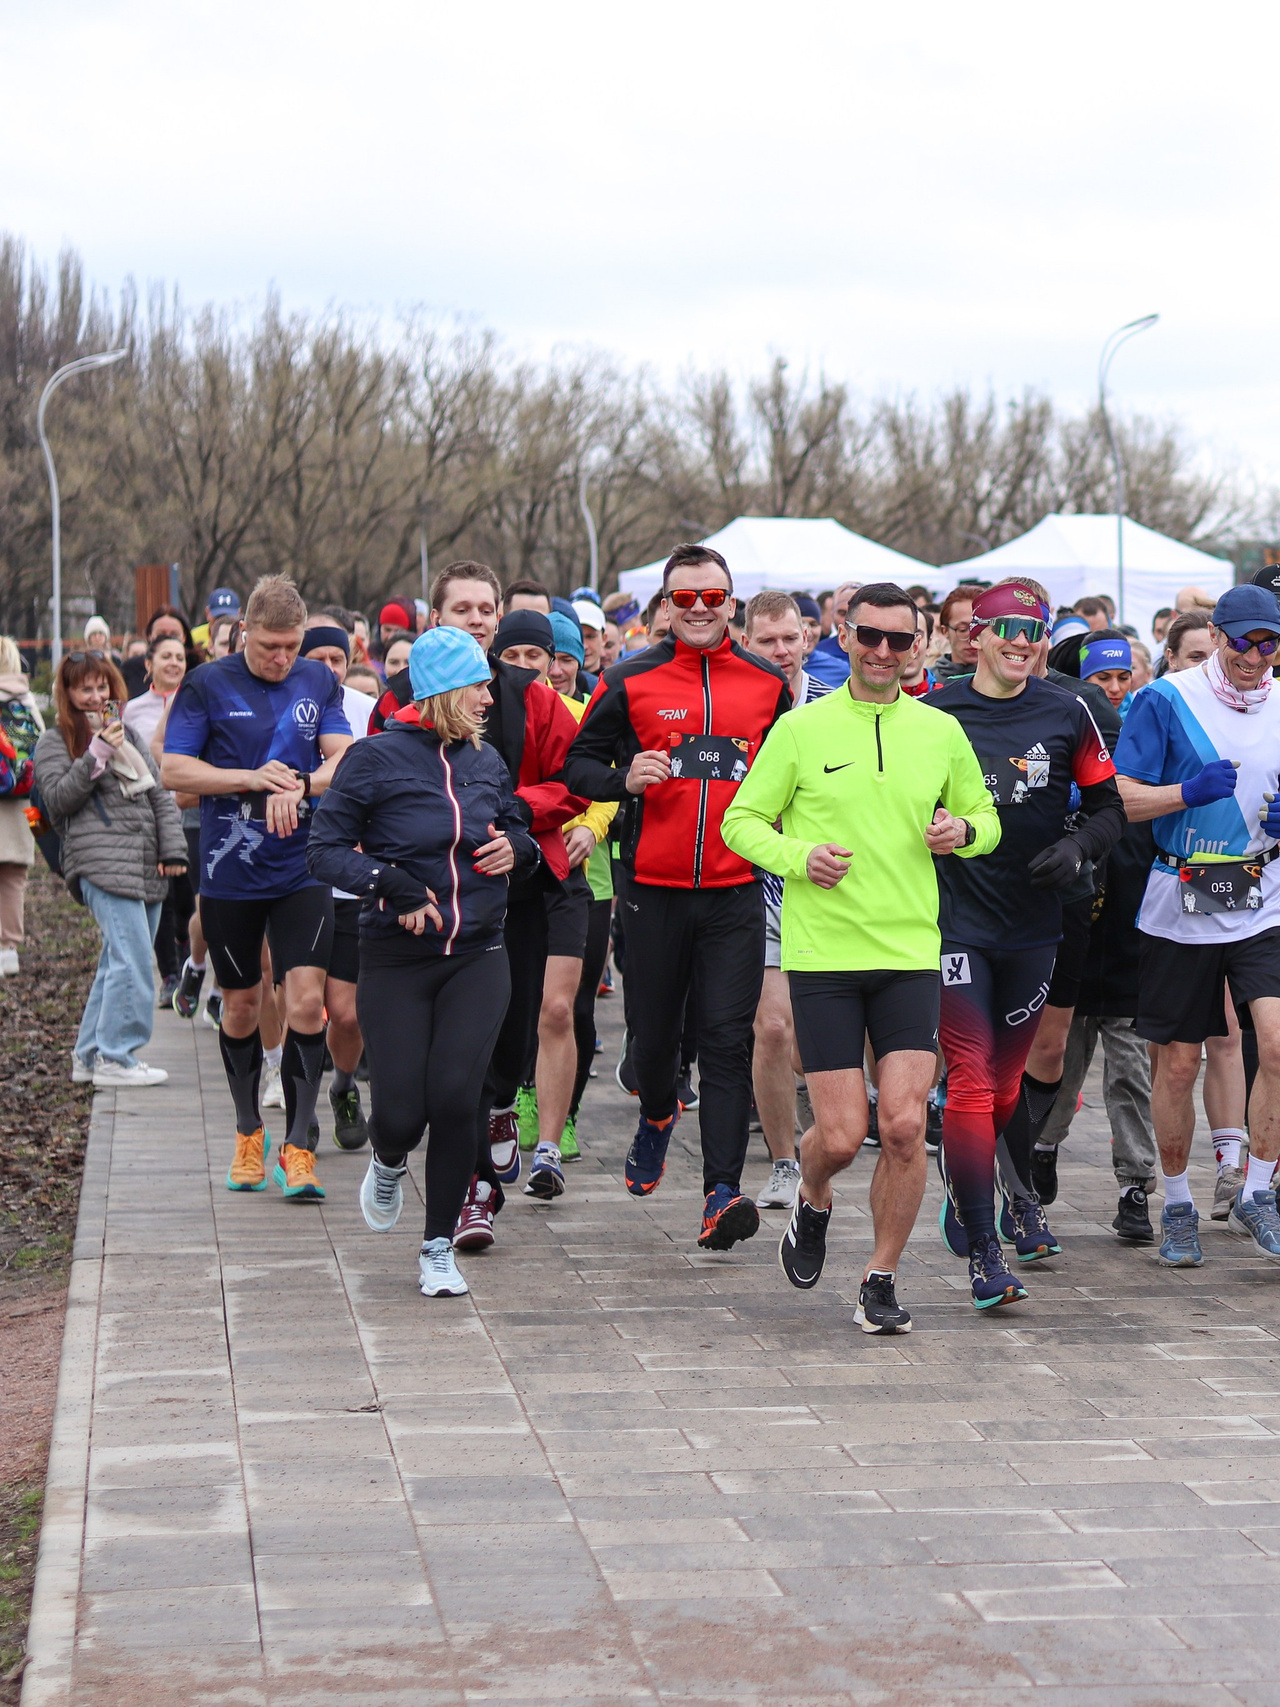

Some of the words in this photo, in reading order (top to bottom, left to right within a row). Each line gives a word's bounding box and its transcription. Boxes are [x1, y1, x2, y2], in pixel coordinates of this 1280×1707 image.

[699, 751, 720, 762] 068
[1185, 827, 1229, 855] Tour
[1211, 881, 1233, 893] 053
